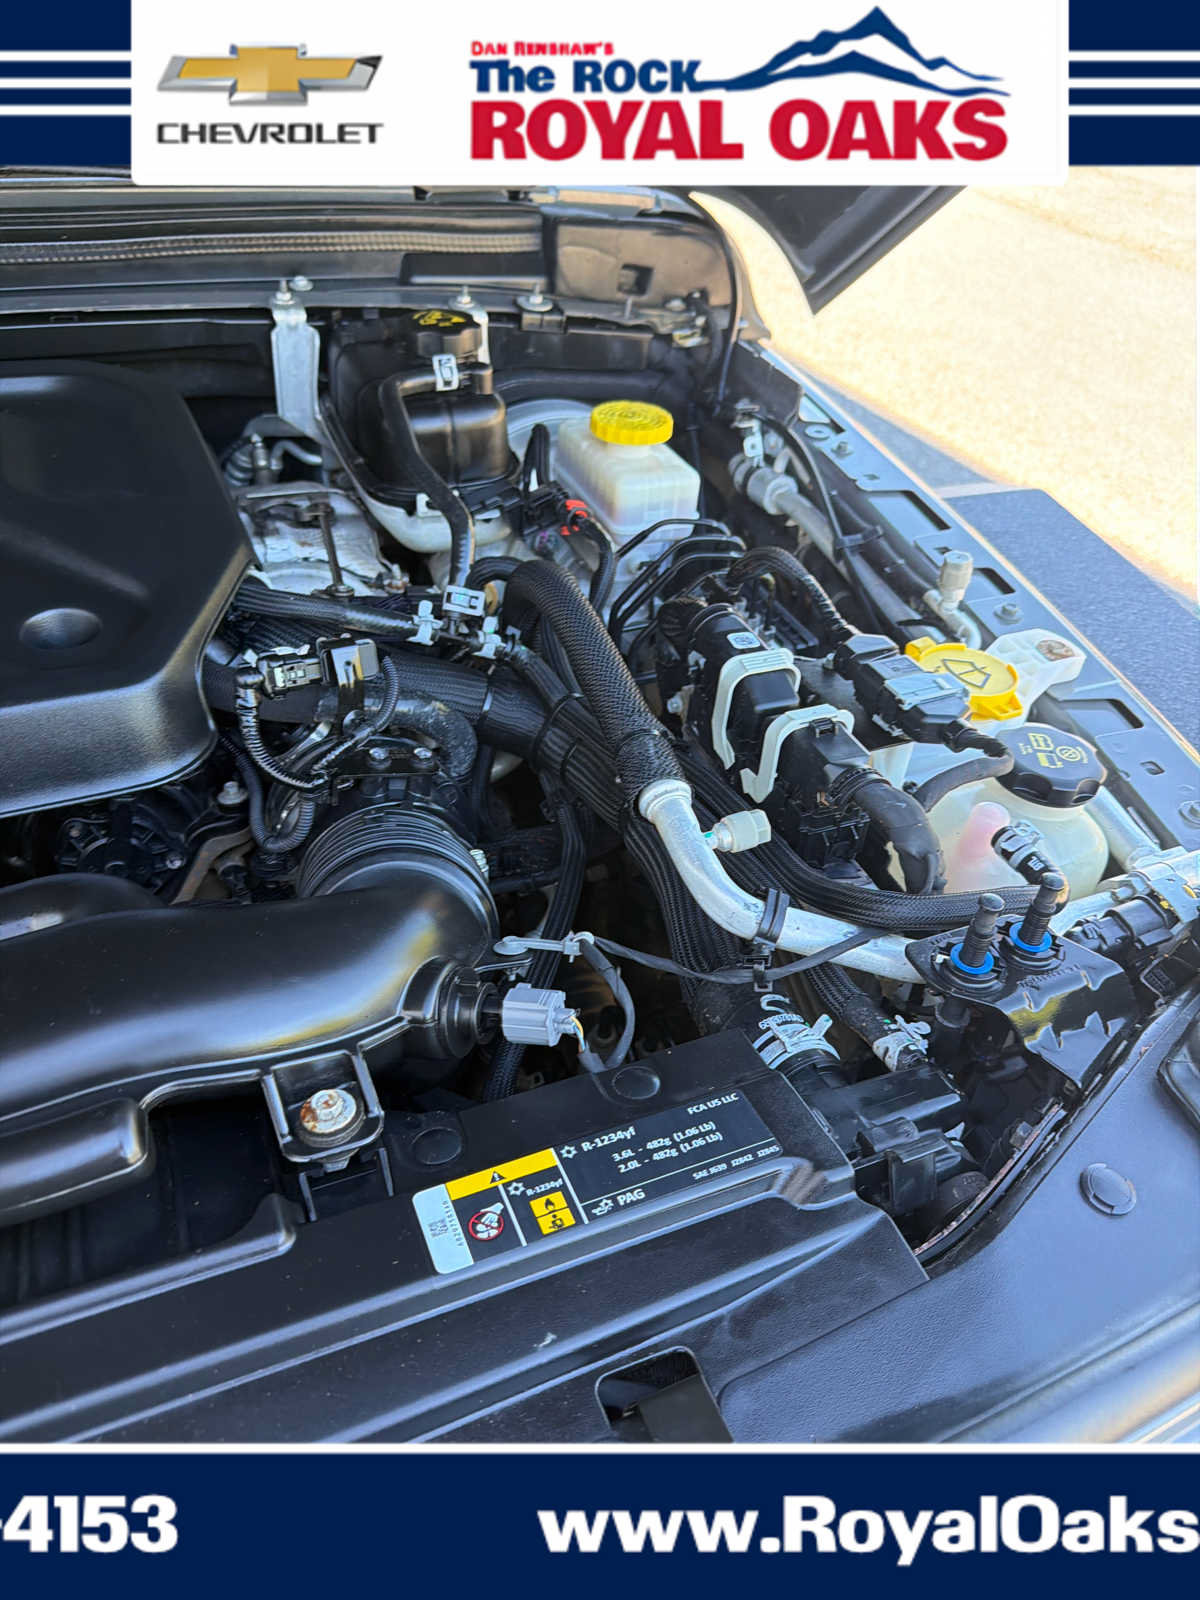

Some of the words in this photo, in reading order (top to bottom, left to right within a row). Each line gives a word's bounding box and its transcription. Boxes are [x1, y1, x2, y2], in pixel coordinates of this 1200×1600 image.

[687, 1103, 708, 1115] FCA
[706, 1098, 721, 1109] US
[721, 1092, 740, 1104] LLC
[581, 1126, 636, 1152] R-1234yf
[612, 1149, 636, 1162] 3.6L
[618, 1160, 642, 1173] 2.0L
[617, 1188, 646, 1206] PAG
